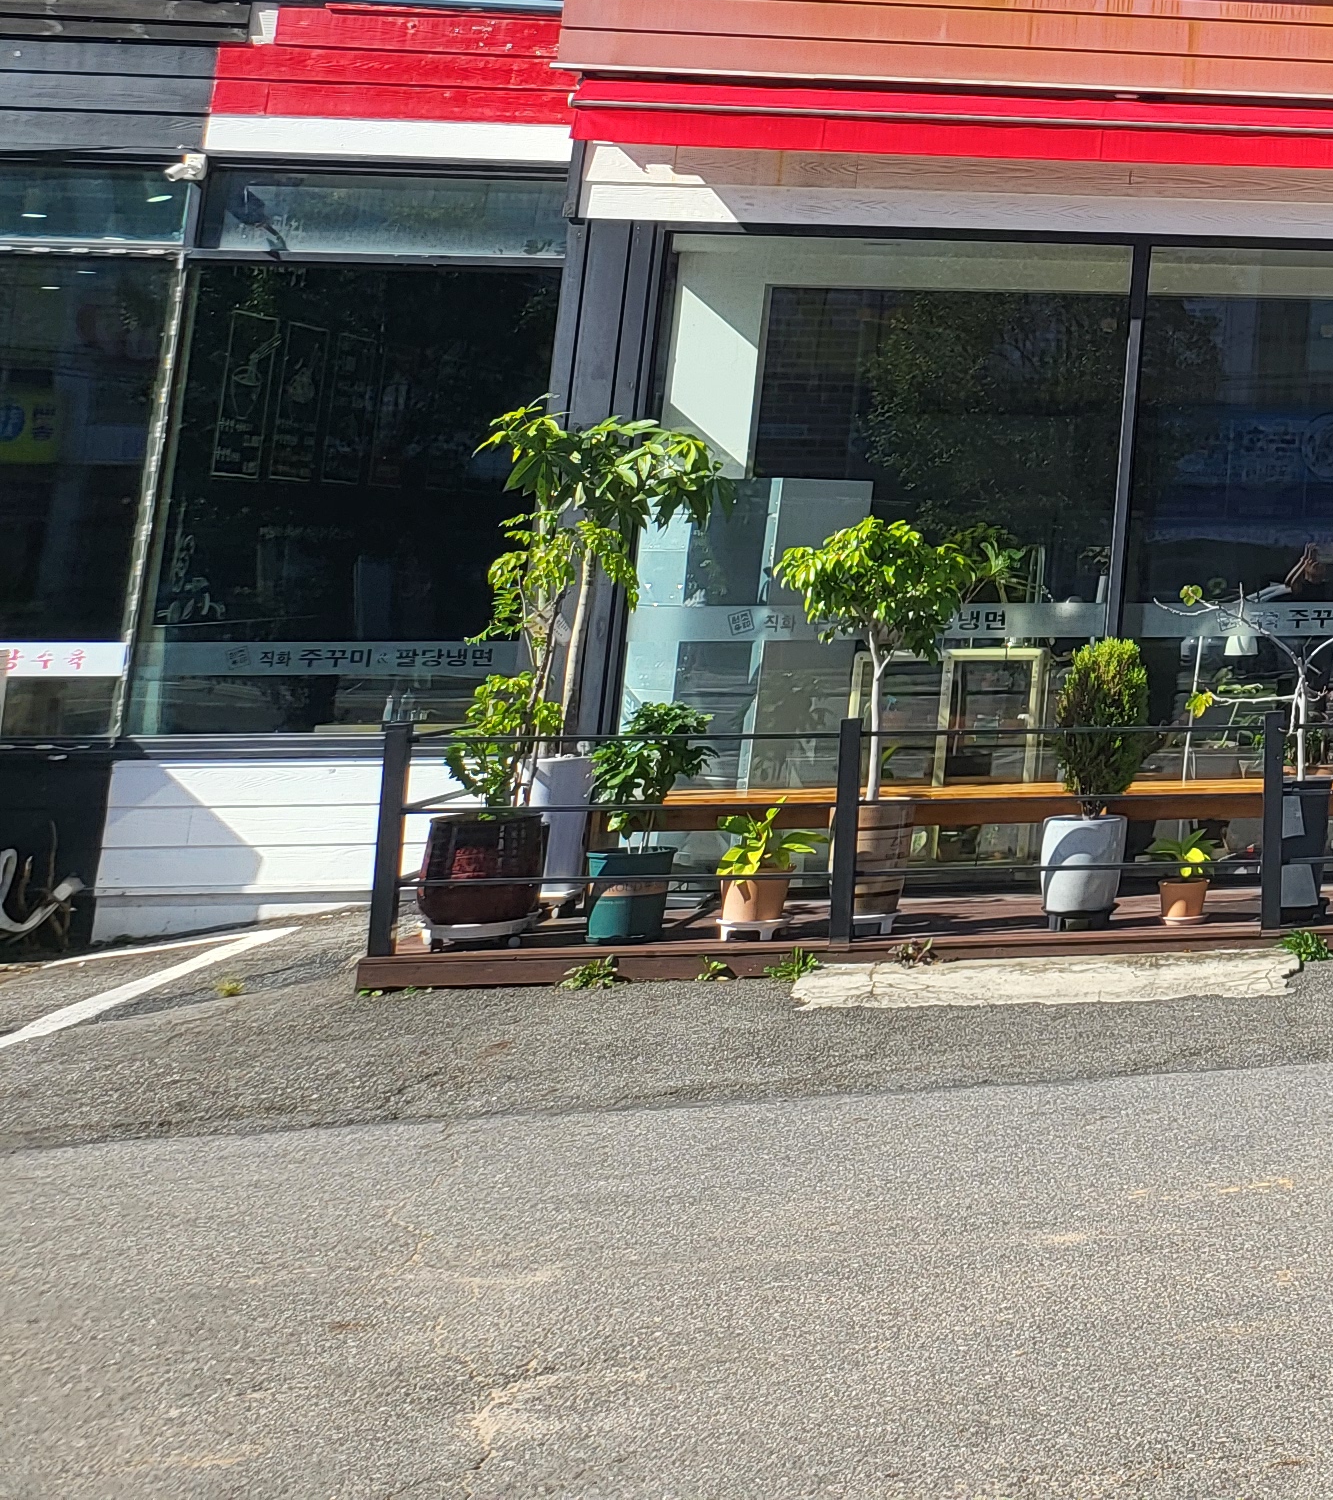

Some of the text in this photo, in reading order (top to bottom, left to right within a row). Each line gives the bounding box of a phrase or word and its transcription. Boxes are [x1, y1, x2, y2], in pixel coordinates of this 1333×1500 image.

[764, 613, 796, 634] 직화
[259, 651, 291, 668] 직화
[298, 648, 373, 668] 주꾸미
[396, 648, 494, 668] 팔당냉면
